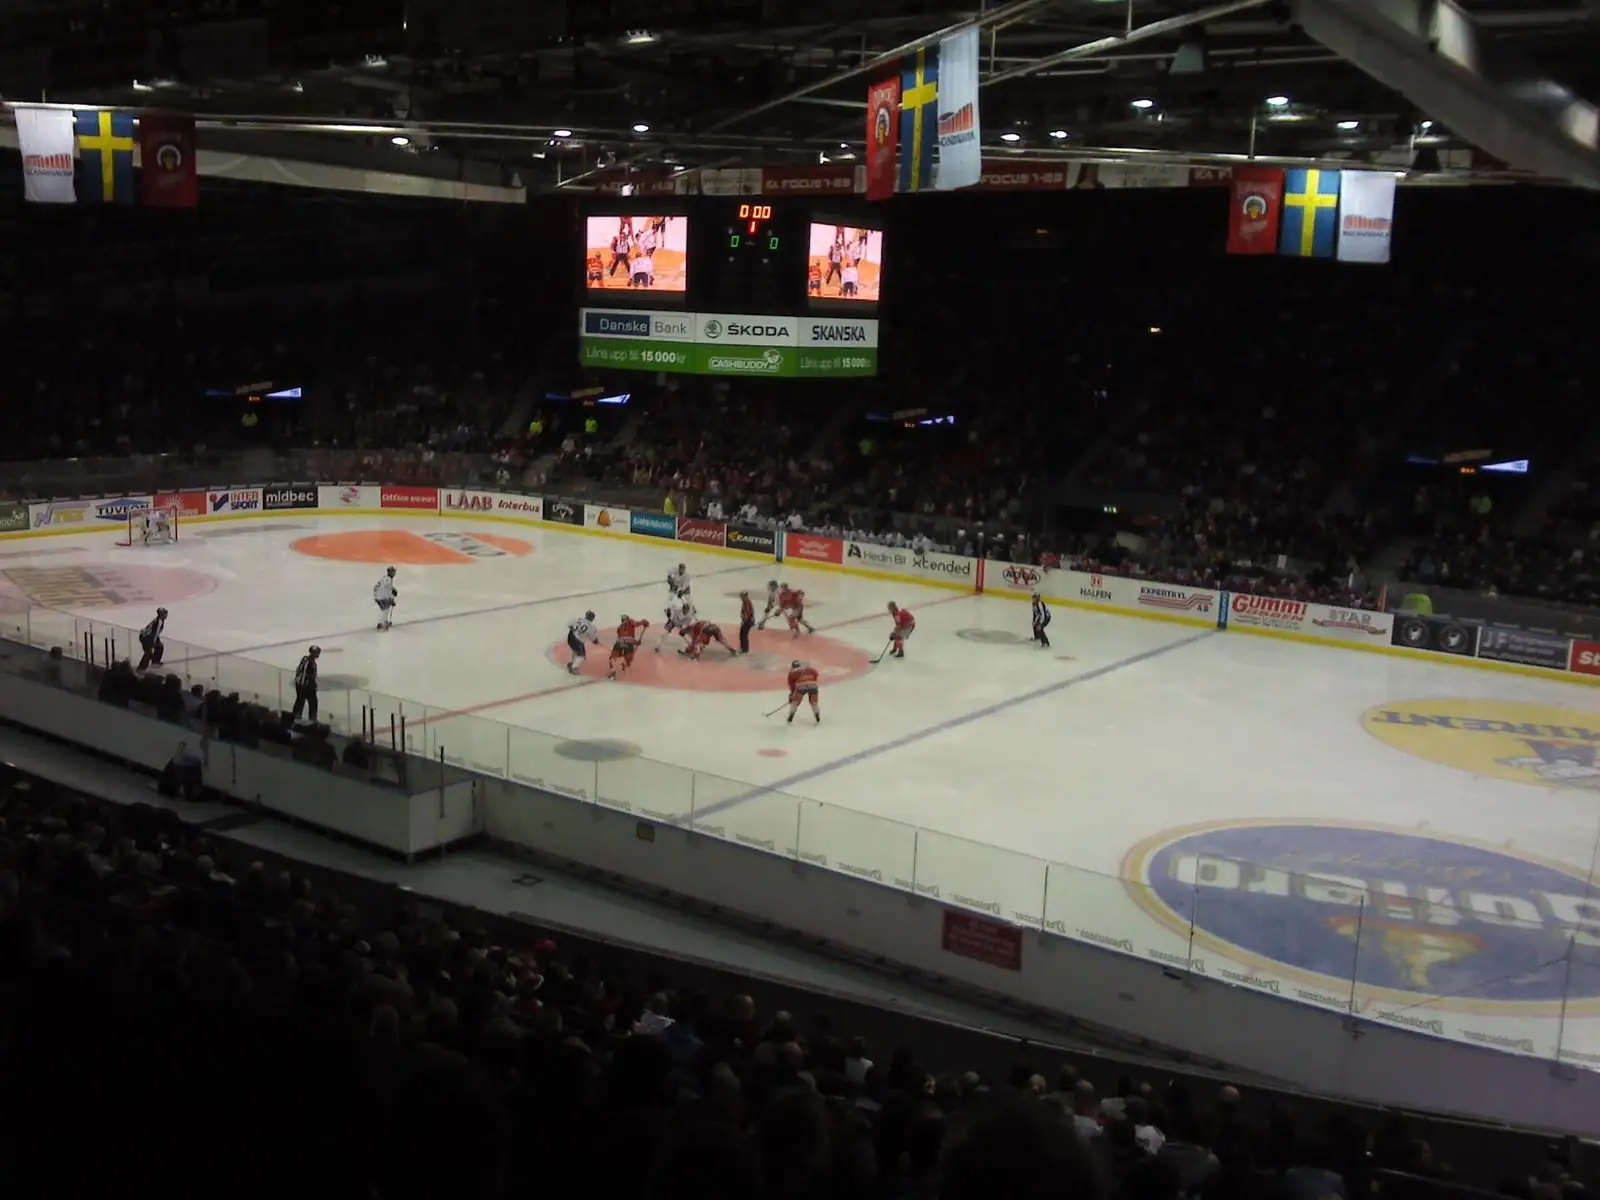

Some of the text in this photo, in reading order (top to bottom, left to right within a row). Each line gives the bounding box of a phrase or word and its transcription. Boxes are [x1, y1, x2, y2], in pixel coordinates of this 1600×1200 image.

[781, 178, 822, 190] FOCUS
[730, 235, 740, 248] 0
[769, 237, 779, 250] 0
[600, 318, 687, 334] Danske Bank
[727, 323, 790, 337] ŠKODA
[812, 325, 866, 342] SKANSKA
[230, 491, 259, 501] INTER
[230, 501, 258, 510] SPORT
[498, 499, 541, 513] Interbus
[736, 533, 773, 545] EASTON
